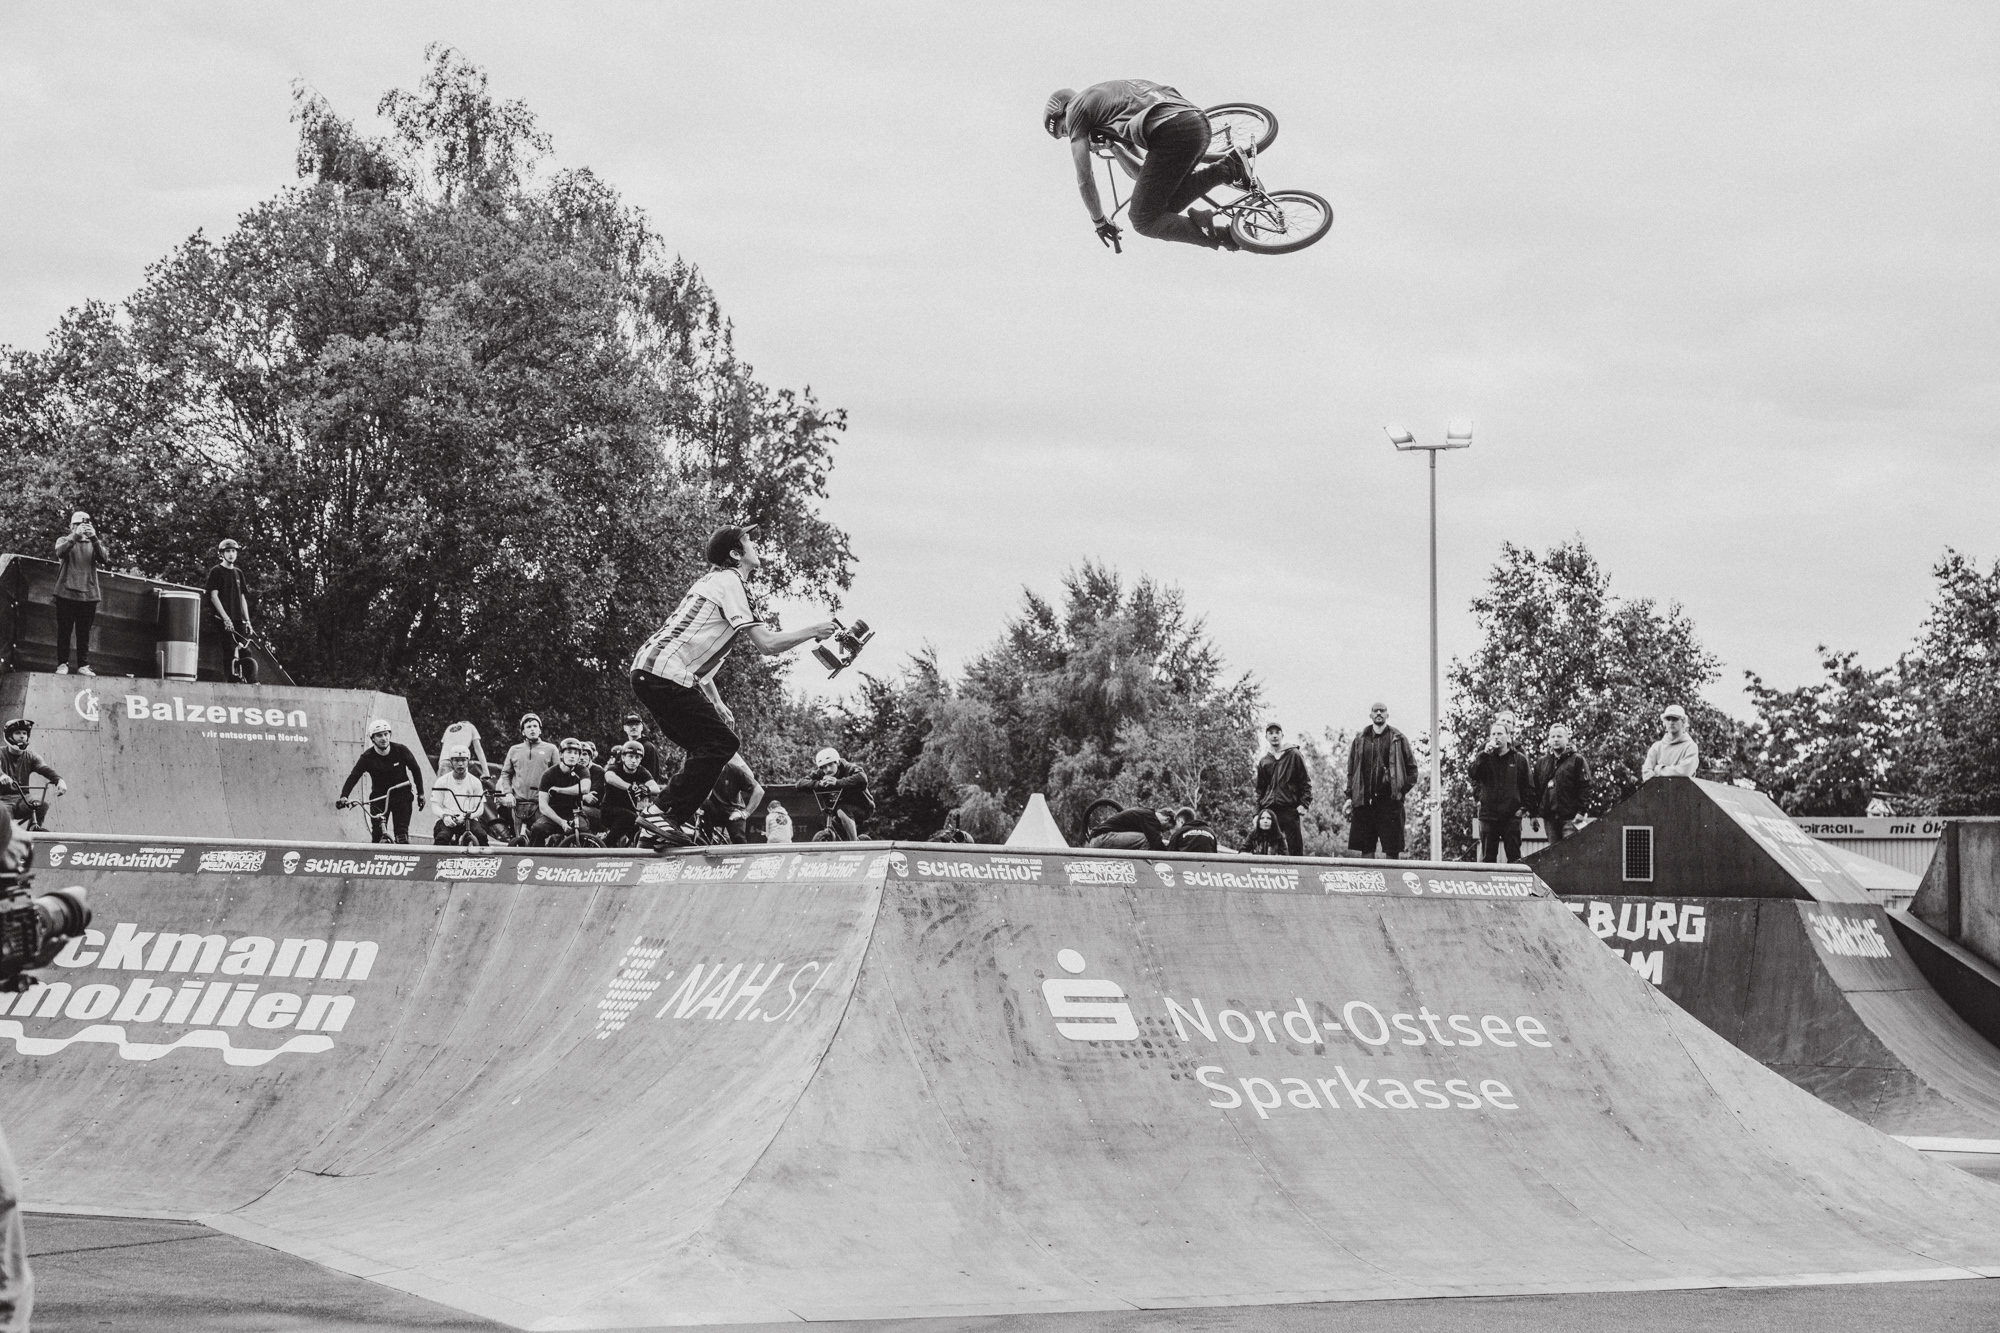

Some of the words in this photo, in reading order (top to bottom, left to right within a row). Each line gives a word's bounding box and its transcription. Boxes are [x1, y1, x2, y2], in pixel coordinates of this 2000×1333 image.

[124, 695, 308, 727] Balzersen
[220, 731, 262, 741] entsorgen
[265, 732, 276, 740] im
[278, 733, 308, 742] Norde
[1890, 823, 1915, 834] mit
[1096, 873, 1136, 881] NAZIS
[1349, 882, 1386, 890] NAZIS
[1612, 949, 1664, 985] M
[1163, 997, 1553, 1048] Nord-Ostsee
[1195, 1065, 1519, 1120] Sparkasse
